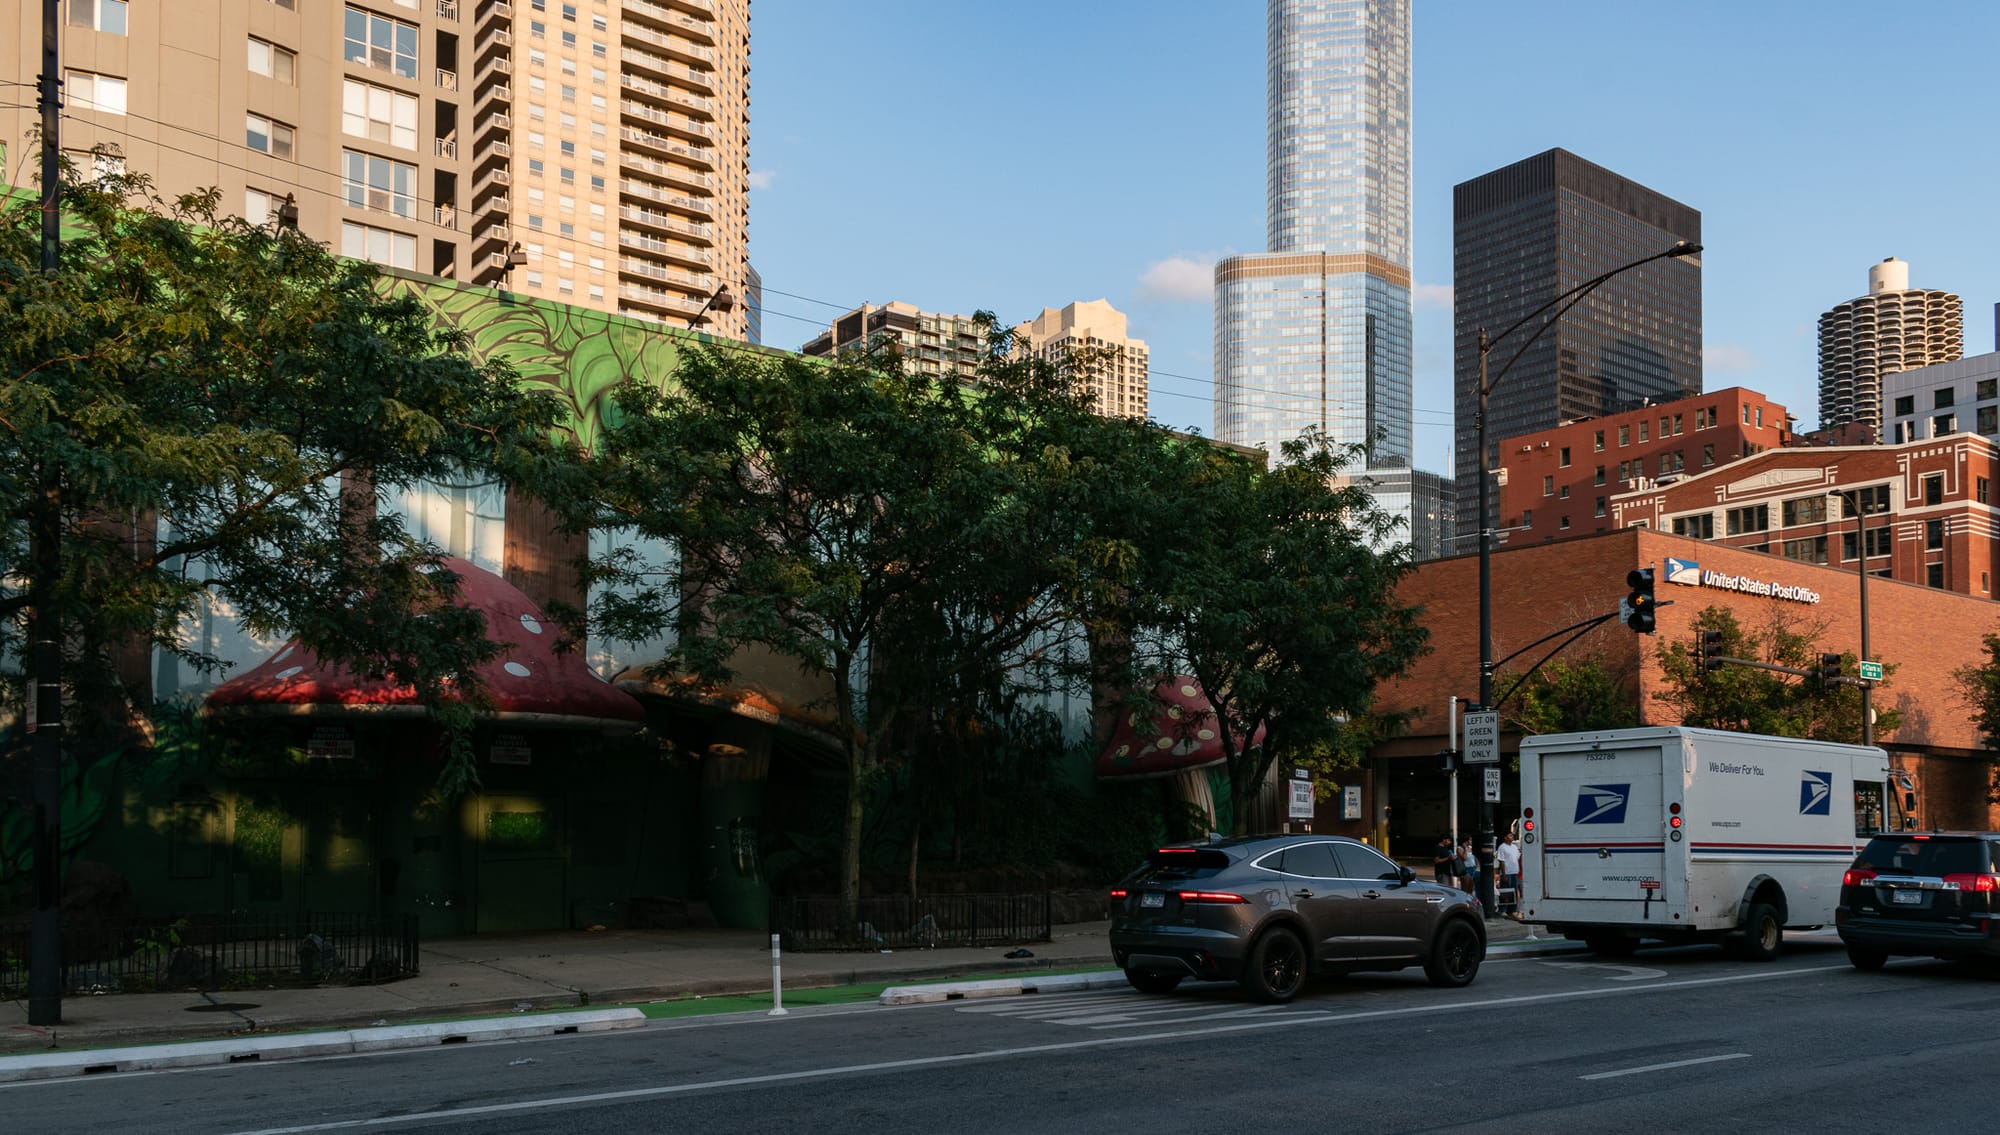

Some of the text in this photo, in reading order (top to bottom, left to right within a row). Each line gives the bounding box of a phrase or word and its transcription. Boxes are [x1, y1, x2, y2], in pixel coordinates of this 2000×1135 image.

[1704, 570, 1739, 590] United
[1739, 577, 1770, 596] States
[1772, 583, 1794, 600] Post
[1794, 587, 1820, 604] Office
[1466, 716, 1495, 725] LEFT ON
[1469, 728, 1492, 736] GREEN
[1469, 739, 1493, 747] ARROW
[1471, 750, 1491, 758] ONLY
[1709, 762, 1719, 773] We
[1720, 763, 1741, 775] Deliver
[1742, 764, 1752, 775] For
[1486, 771, 1498, 780] ONE
[1486, 781, 1499, 789] WAY
